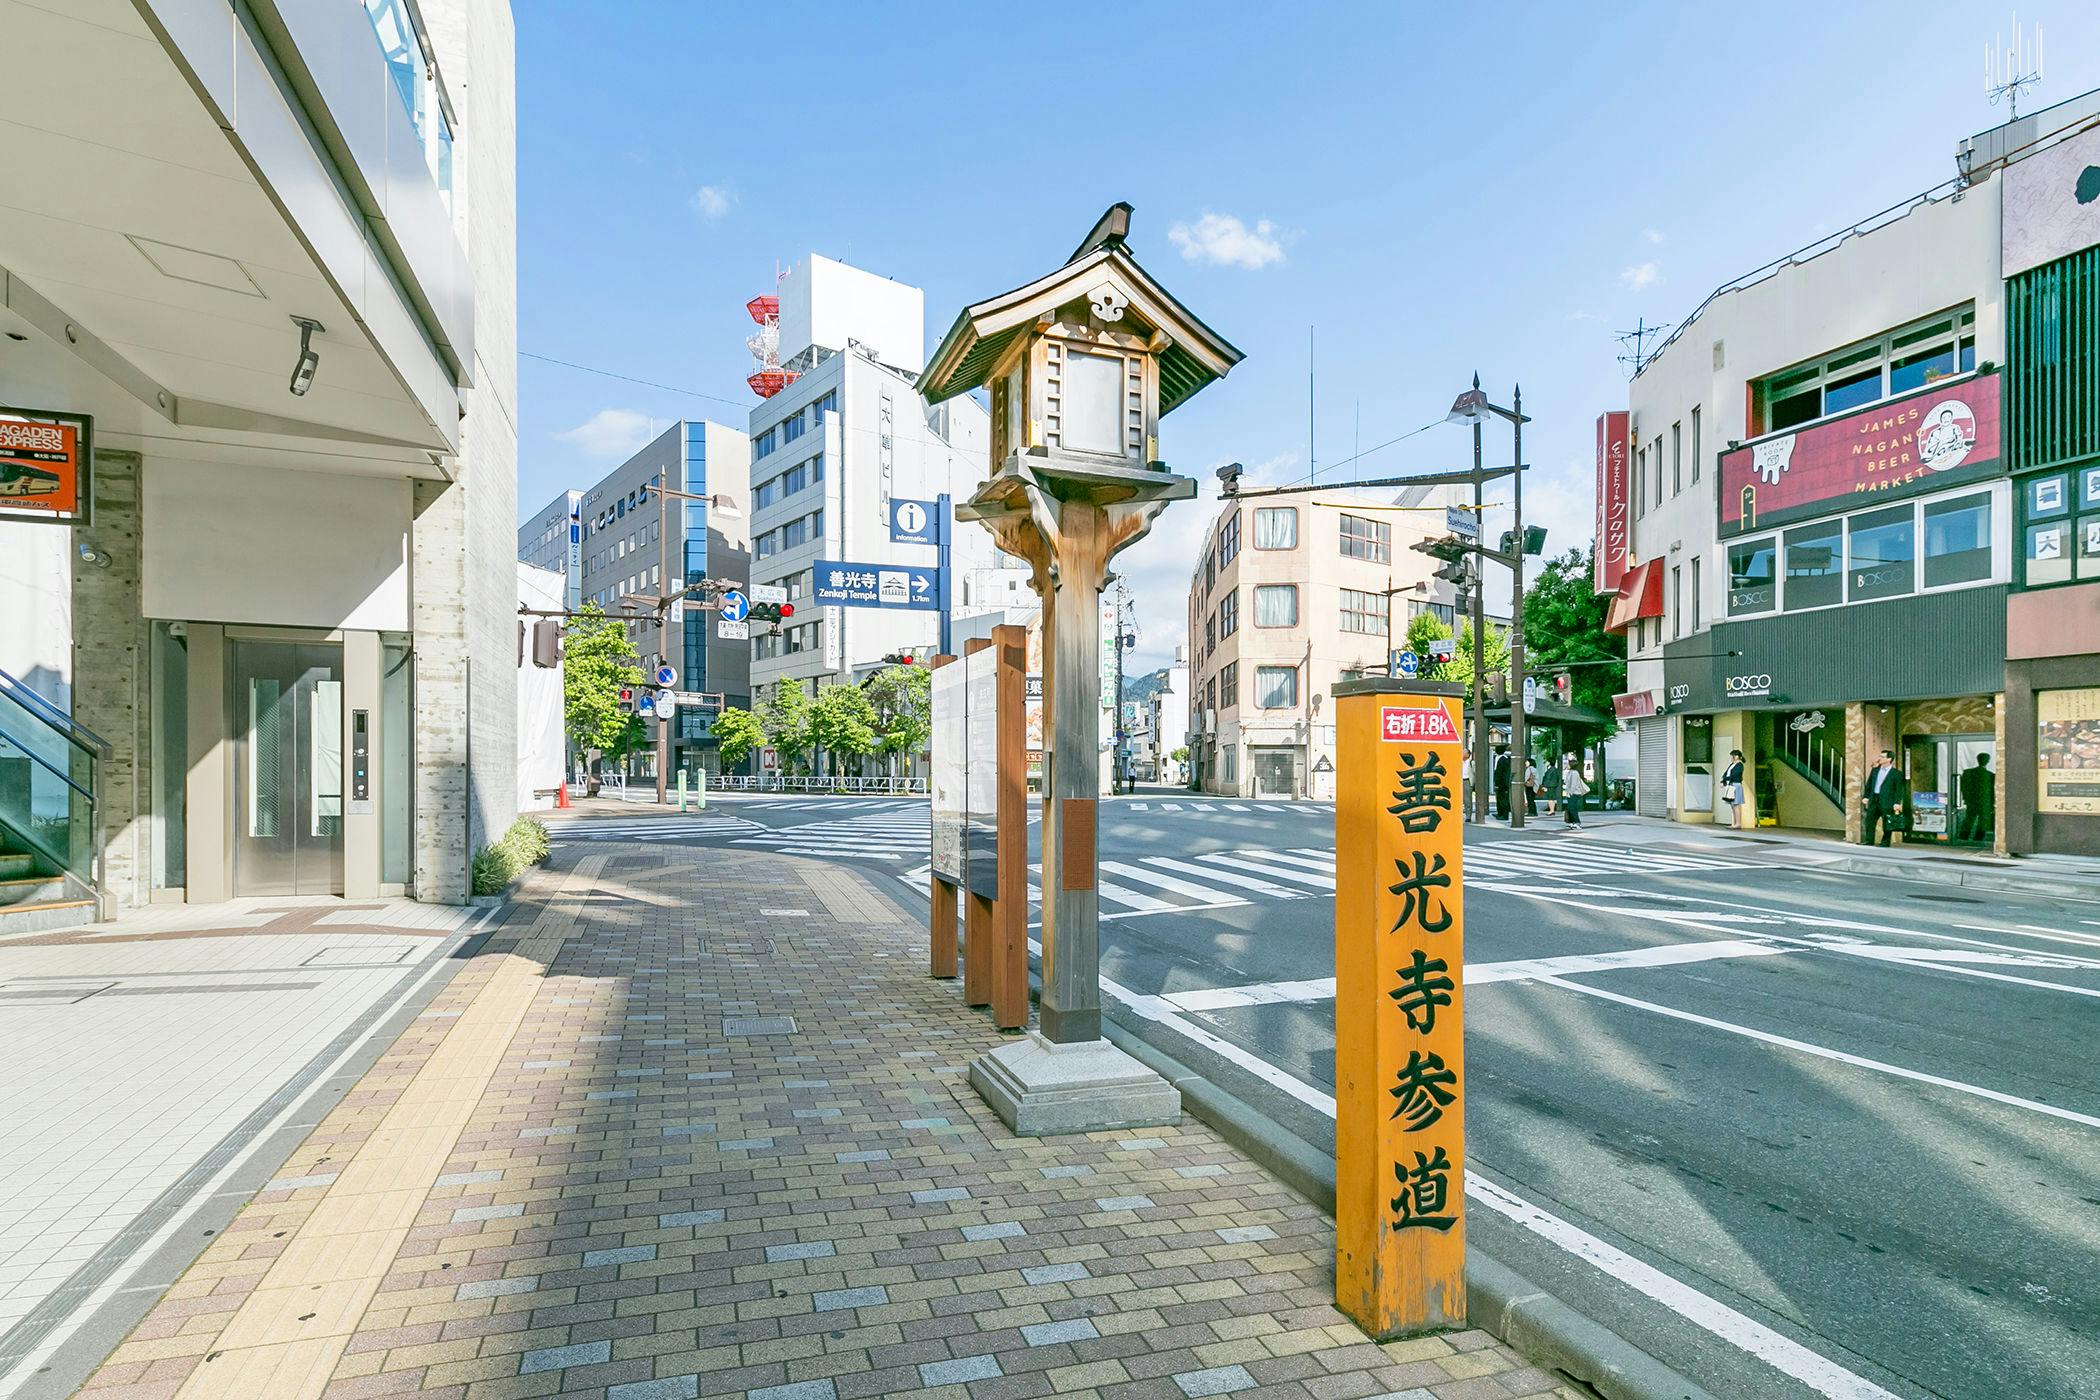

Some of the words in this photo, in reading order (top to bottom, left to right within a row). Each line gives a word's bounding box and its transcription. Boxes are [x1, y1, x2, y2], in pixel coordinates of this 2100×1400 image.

[1860, 409, 1918, 433] JAMES
[1852, 427, 1926, 455] NAGANO
[1867, 453, 1910, 472] BEER
[1855, 467, 1924, 492] MARKET
[829, 570, 877, 589] 善光寺
[818, 588, 848, 600] Zenkoji
[849, 590, 877, 602] Temple
[1026, 680, 1043, 695] 菓
[1726, 674, 1771, 691] BOSCO
[1386, 713, 1416, 735] 右折
[1386, 751, 1459, 1232] 善光寺参道
